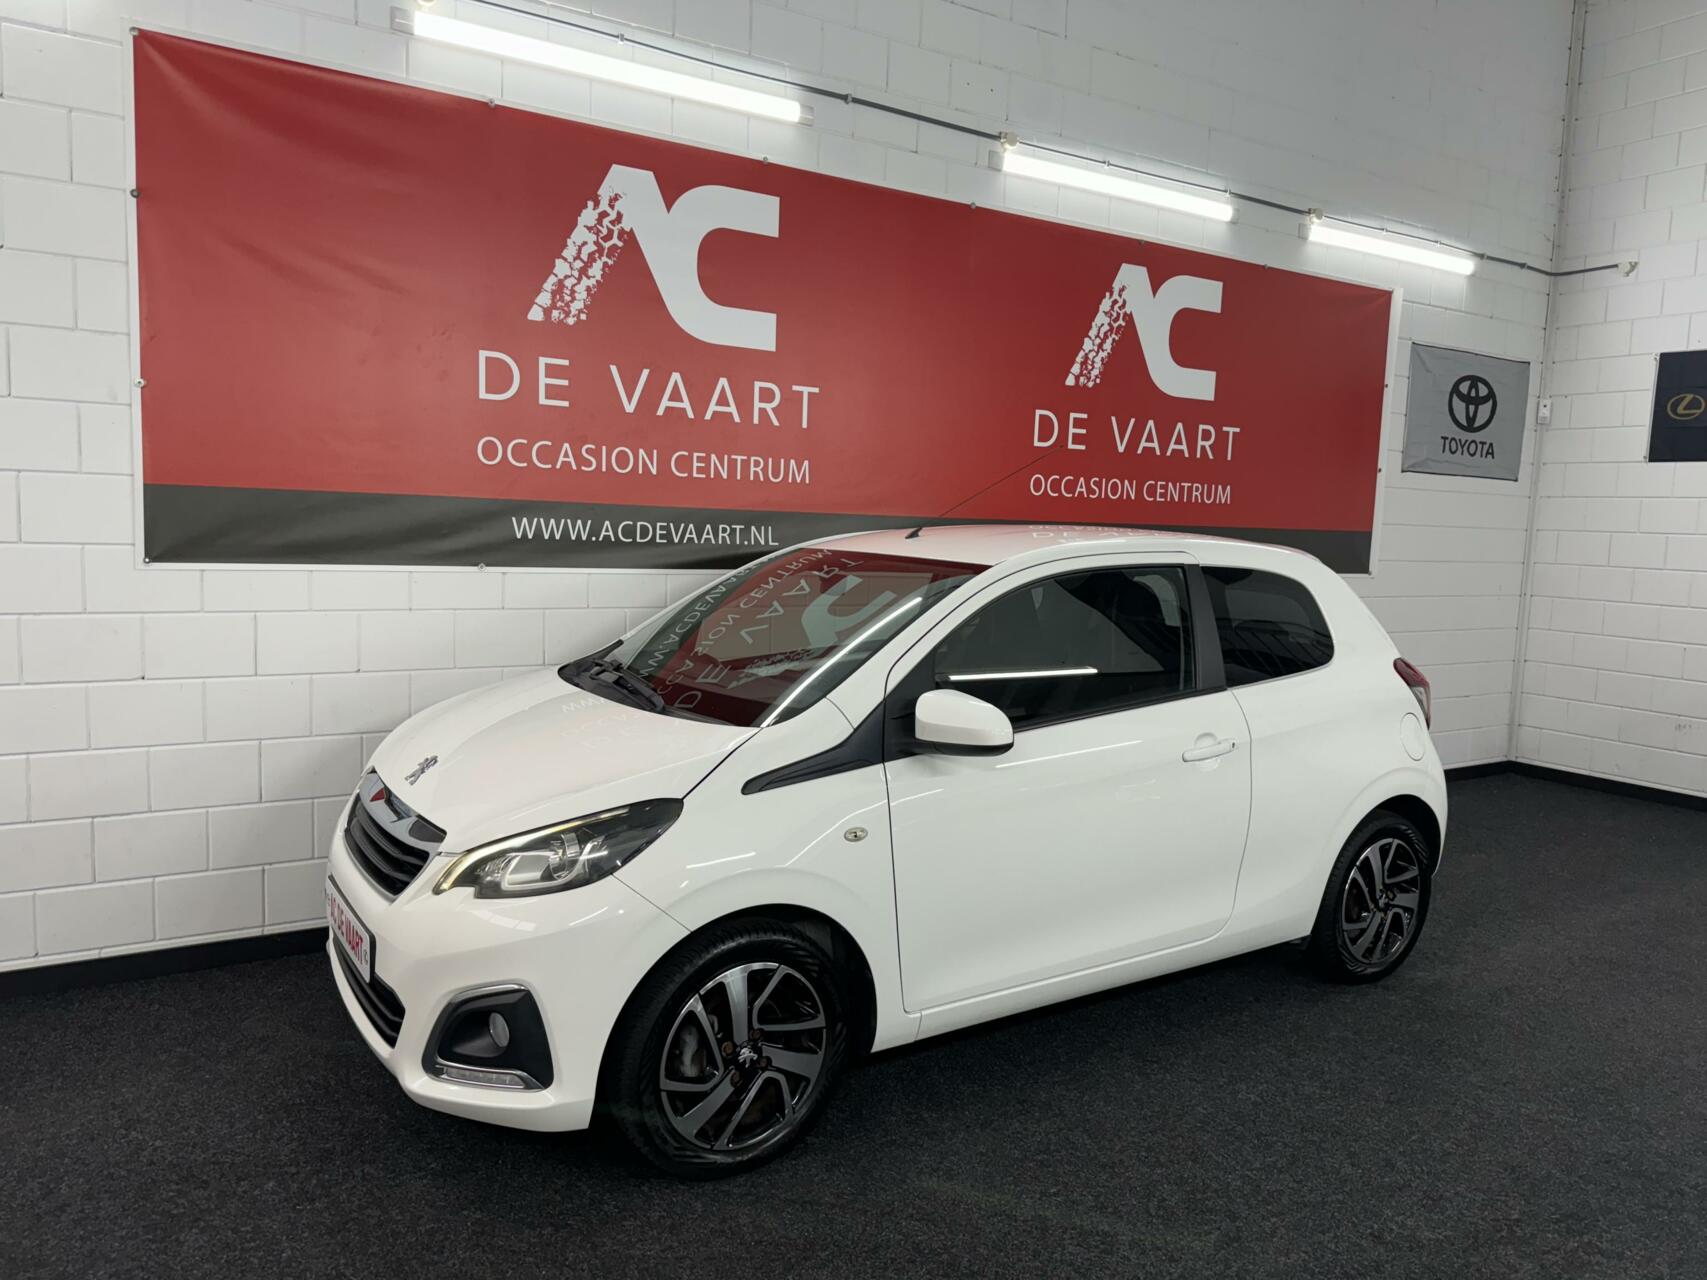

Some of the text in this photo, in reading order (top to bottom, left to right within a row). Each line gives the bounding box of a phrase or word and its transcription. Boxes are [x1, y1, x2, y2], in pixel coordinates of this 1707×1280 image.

[527, 163, 781, 352] AC
[1065, 263, 1223, 401] AC
[479, 350, 820, 428] DE VAART
[1034, 410, 1240, 460] DE VAART
[1441, 436, 1494, 459] TOYOTA
[477, 437, 809, 483] OCCASION CENTRUM
[1030, 474, 1230, 504] OCCASION CENTRUM
[512, 517, 778, 545] WWW.ACDEVAART.NL
